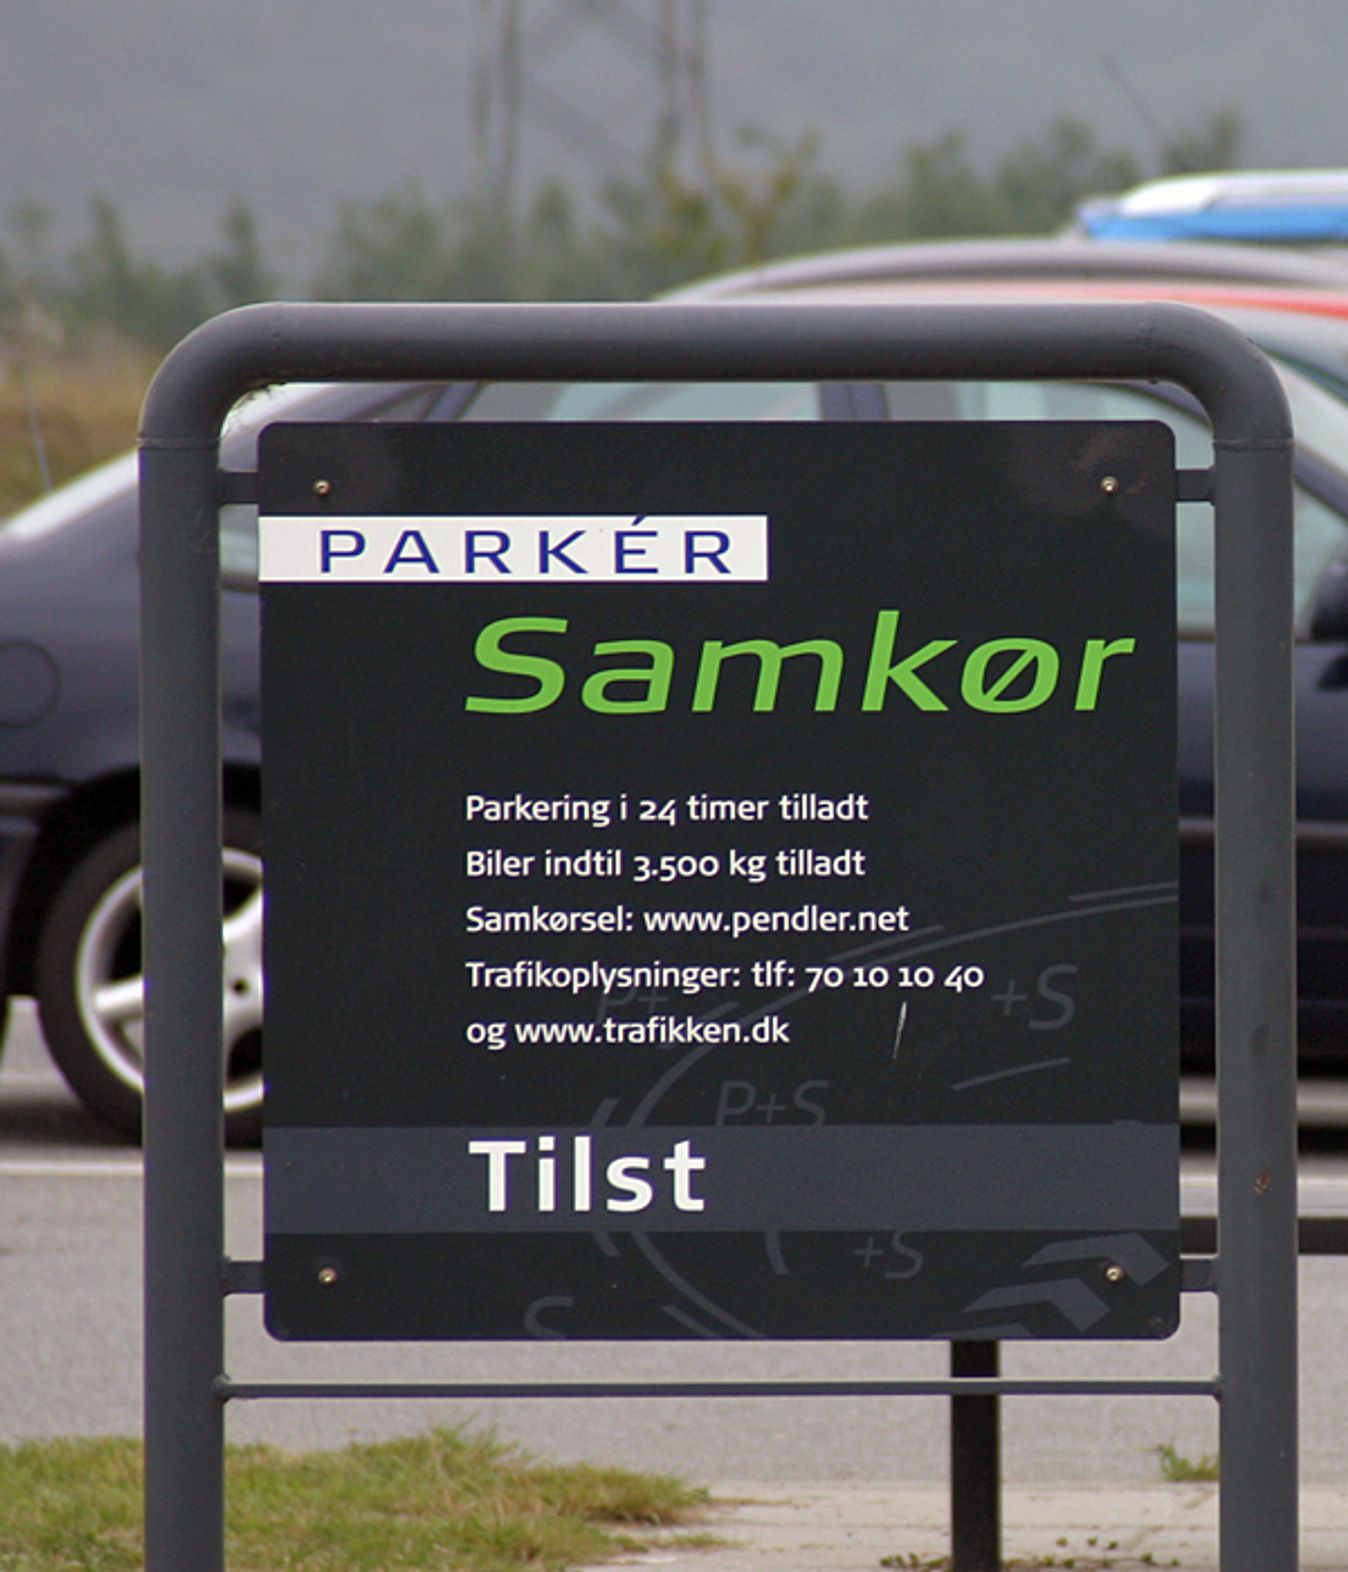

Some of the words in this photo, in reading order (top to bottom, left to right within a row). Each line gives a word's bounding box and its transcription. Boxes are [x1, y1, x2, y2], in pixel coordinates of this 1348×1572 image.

[319, 515, 732, 575] PARKÉR
[464, 609, 1136, 714] Samkør
[466, 793, 611, 828] Parkering
[620, 793, 627, 821] i
[639, 799, 676, 827] 24
[686, 793, 770, 821] timer
[778, 793, 869, 821] tilladt
[466, 849, 536, 877] Biler
[545, 848, 622, 877] indtil
[633, 855, 720, 882] 3.500
[729, 848, 767, 883] kg
[775, 848, 866, 876] tilladt
[466, 904, 633, 933] Samkørsel:
[643, 904, 910, 939] www.pendler.net
[464, 960, 741, 995] Trafikoplysninger:
[750, 959, 795, 988] tlf:
[804, 966, 844, 993] 70
[853, 966, 889, 988] 10
[898, 966, 935, 988] 10
[943, 965, 985, 993] 40
[466, 1022, 507, 1051] og
[514, 1015, 790, 1044] www.trafikken.dk
[468, 1135, 706, 1212] Tilst
